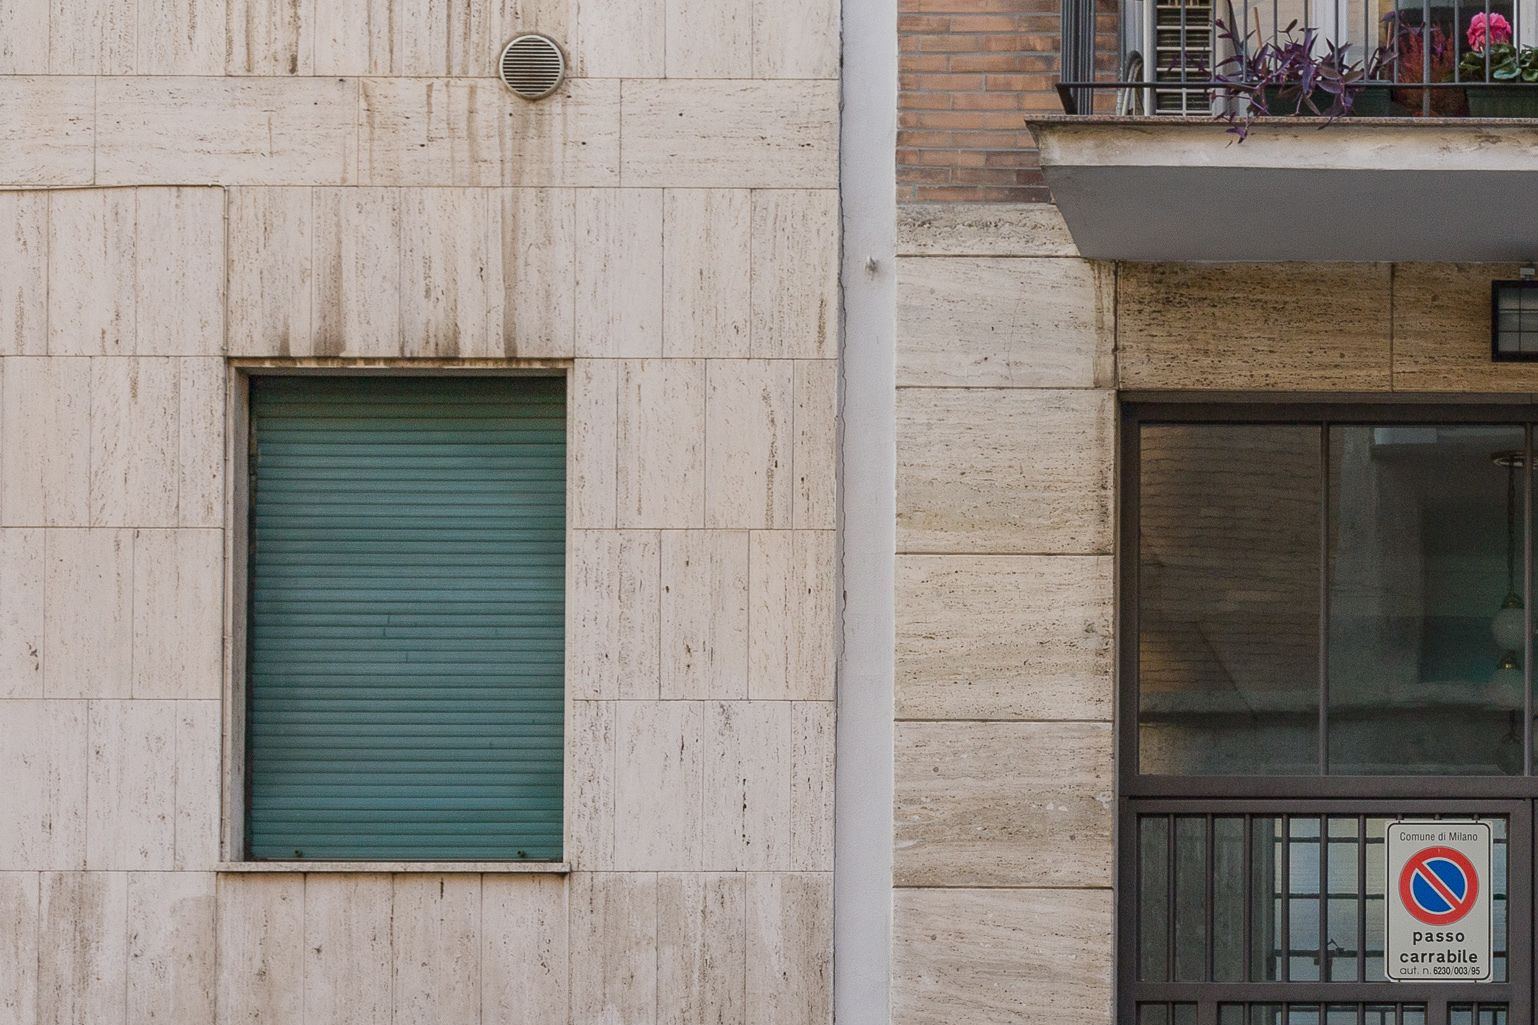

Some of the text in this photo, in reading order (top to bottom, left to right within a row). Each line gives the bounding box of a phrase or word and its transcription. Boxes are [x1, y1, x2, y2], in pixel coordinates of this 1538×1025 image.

[1399, 831, 1478, 841] Comune di Milano
[1413, 931, 1465, 945] passo
[1400, 949, 1478, 963] carrabile
[1399, 966, 1481, 975] aut. n. 6230/003/95
